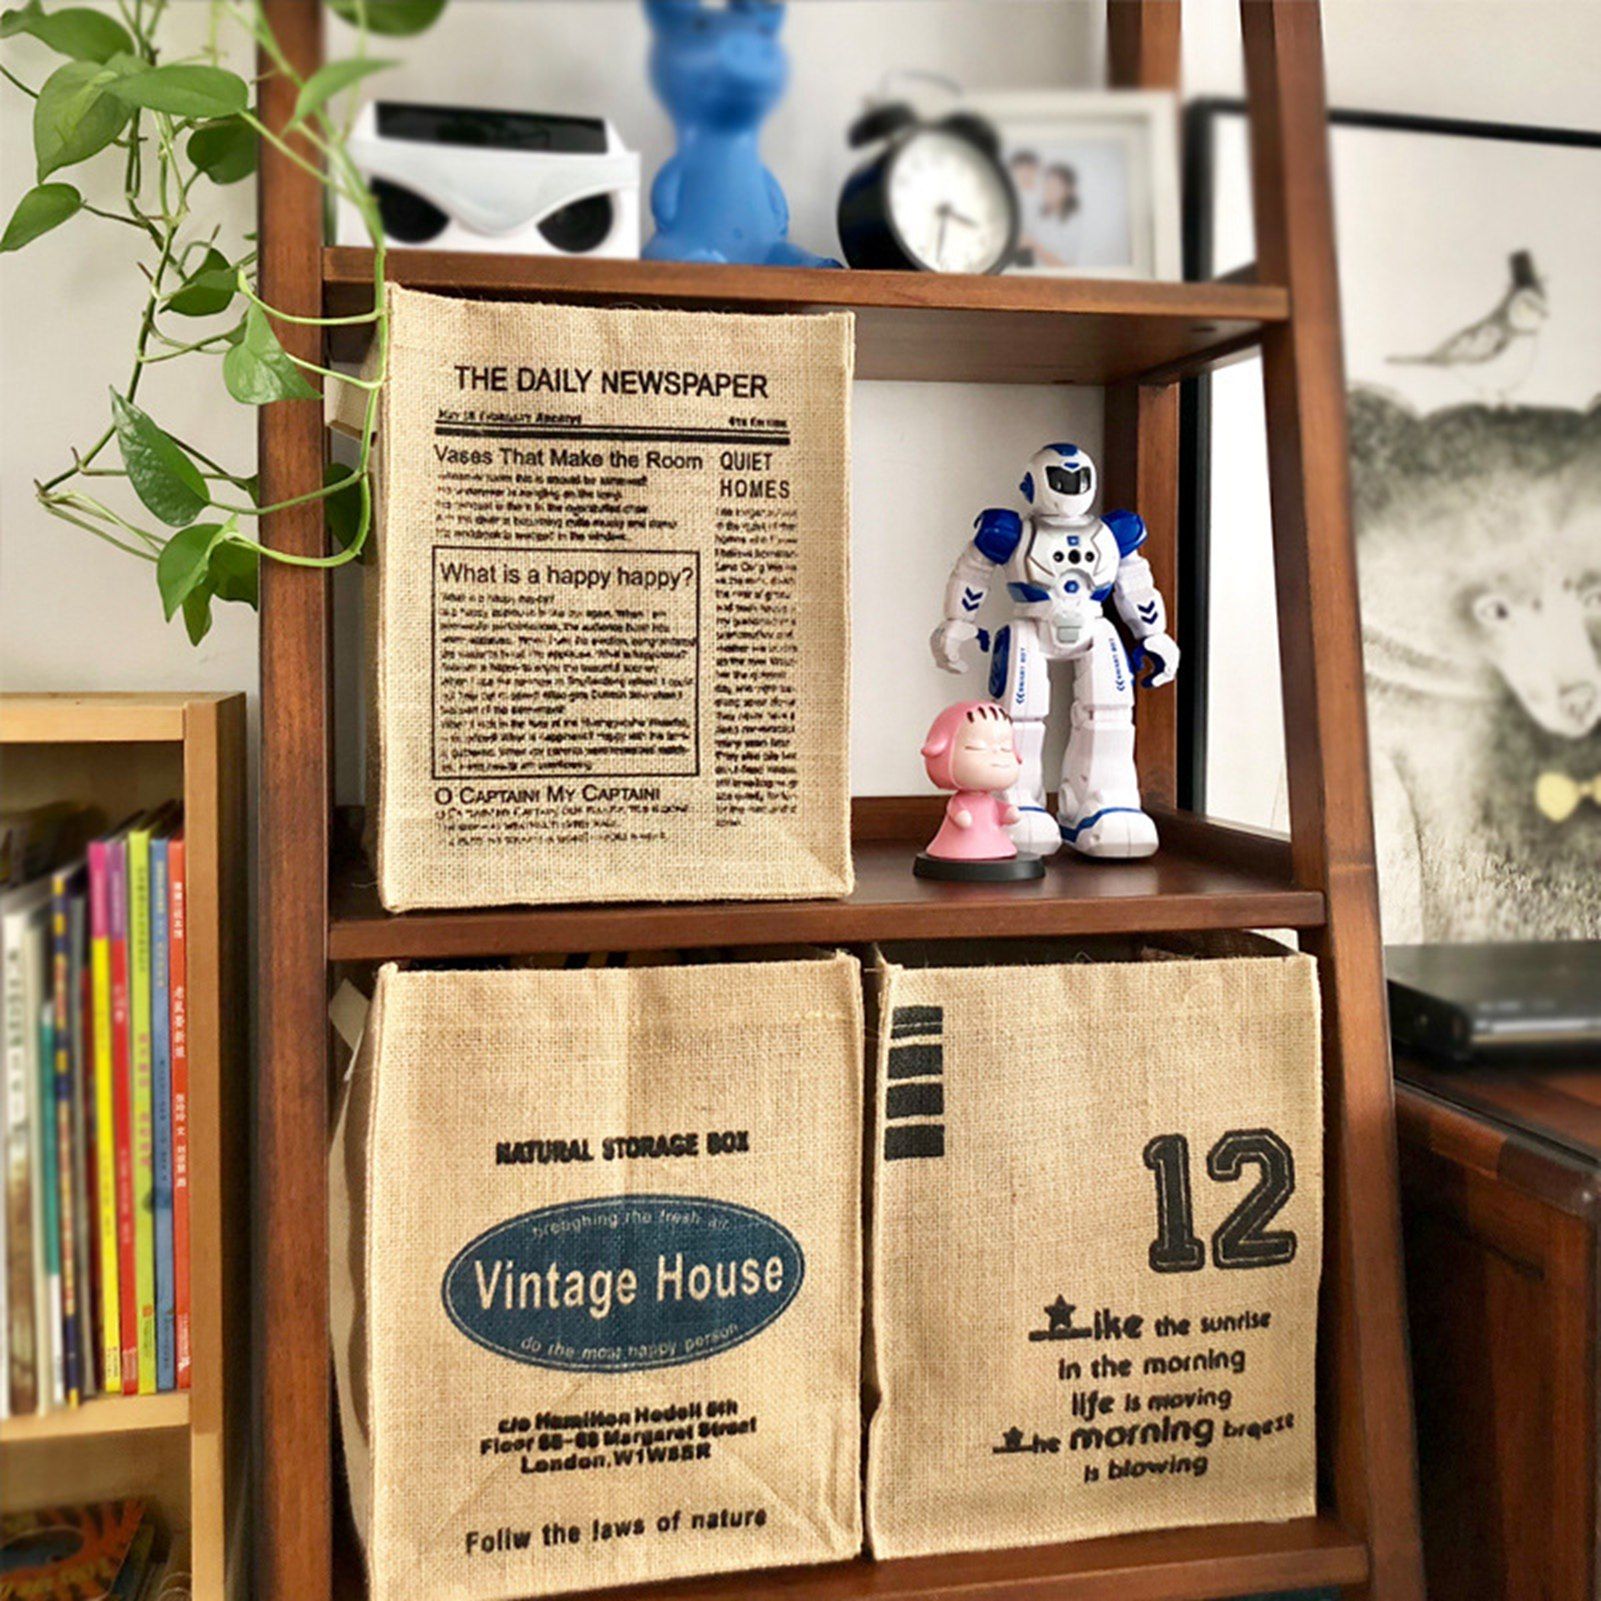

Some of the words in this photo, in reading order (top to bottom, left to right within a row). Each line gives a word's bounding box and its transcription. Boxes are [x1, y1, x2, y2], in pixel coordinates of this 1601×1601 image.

[454, 365, 507, 391] THE
[517, 367, 593, 394] DAILY
[602, 370, 768, 399] NEWSPAPER
[434, 444, 493, 465] Vases
[500, 448, 544, 467] That
[550, 449, 601, 469] Make
[610, 451, 638, 469] the
[645, 452, 703, 470] Room
[720, 452, 773, 472] QUIET
[720, 479, 790, 499] HOMES
[440, 563, 496, 584] What
[503, 565, 519, 585] is
[528, 569, 541, 585] a
[548, 565, 611, 590] happy
[617, 566, 694, 590] happy?
[435, 786, 452, 805] O
[496, 1140, 594, 1165] NATURAL
[602, 1133, 698, 1161] STORAGE
[707, 1130, 749, 1155] BOX
[1143, 1128, 1297, 1273] 12
[475, 1259, 638, 1319] Vintage
[657, 1252, 784, 1302] House
[1154, 1315, 1191, 1338] the
[1200, 1309, 1272, 1334] sunrise
[520, 1336, 542, 1353] do
[547, 1340, 574, 1359] the
[1091, 1354, 1132, 1379] the
[1143, 1348, 1246, 1375] morning
[1072, 1391, 1115, 1422] life
[1124, 1393, 1142, 1413] is
[1147, 1387, 1232, 1411] moving
[480, 1437, 534, 1456] Floor
[603, 1424, 694, 1446] Margaret
[698, 1416, 757, 1438] Street
[1070, 1416, 1215, 1451] morning
[1223, 1412, 1294, 1441] breeze
[1084, 1465, 1099, 1483] is
[1108, 1455, 1208, 1480] blowing
[542, 1522, 580, 1546] the
[593, 1517, 645, 1542] laws
[657, 1510, 681, 1532] of
[691, 1507, 767, 1531] nature
